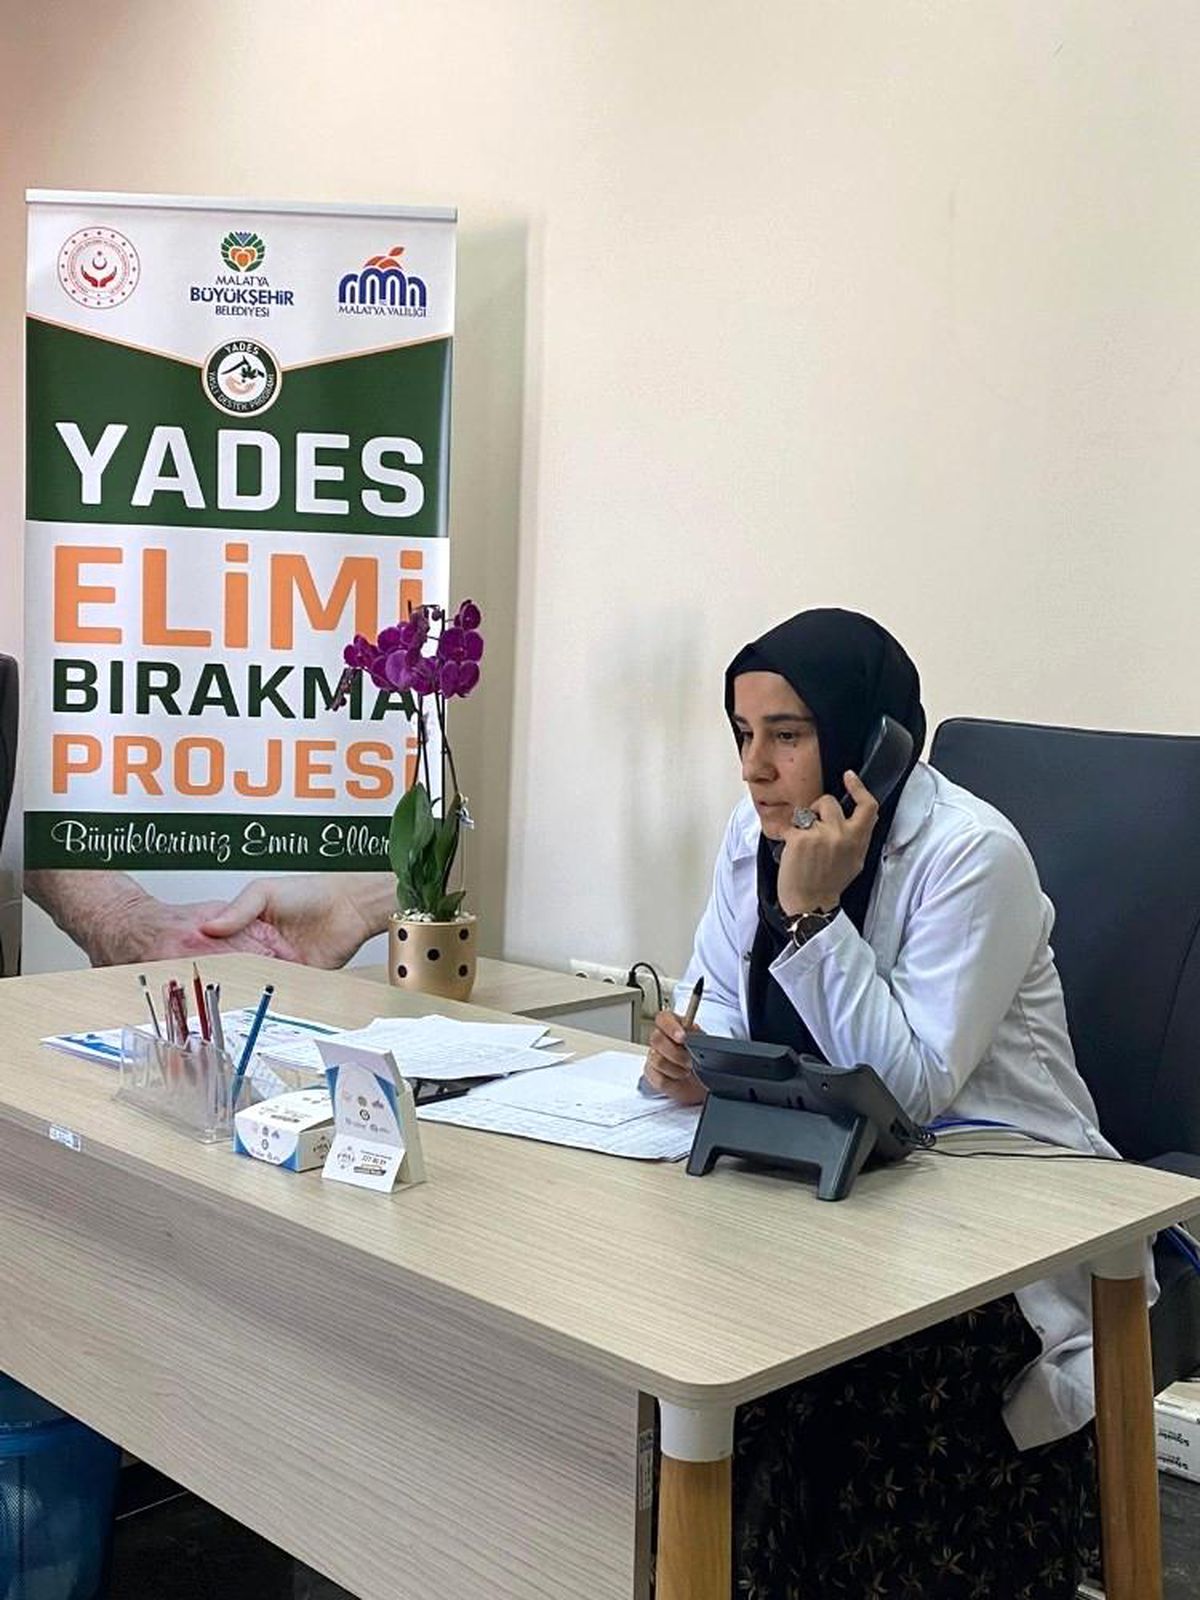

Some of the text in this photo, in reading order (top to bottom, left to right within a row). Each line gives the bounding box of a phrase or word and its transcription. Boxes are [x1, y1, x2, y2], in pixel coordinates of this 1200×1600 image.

[215, 275, 269, 287] MALATYA
[339, 305, 386, 316] MALATYA
[224, 342, 260, 355] YADES
[55, 422, 425, 518] YADES
[52, 658, 417, 721] BIRAKMA
[51, 820, 231, 863] Büyüklerimiz
[241, 821, 309, 856] Emin
